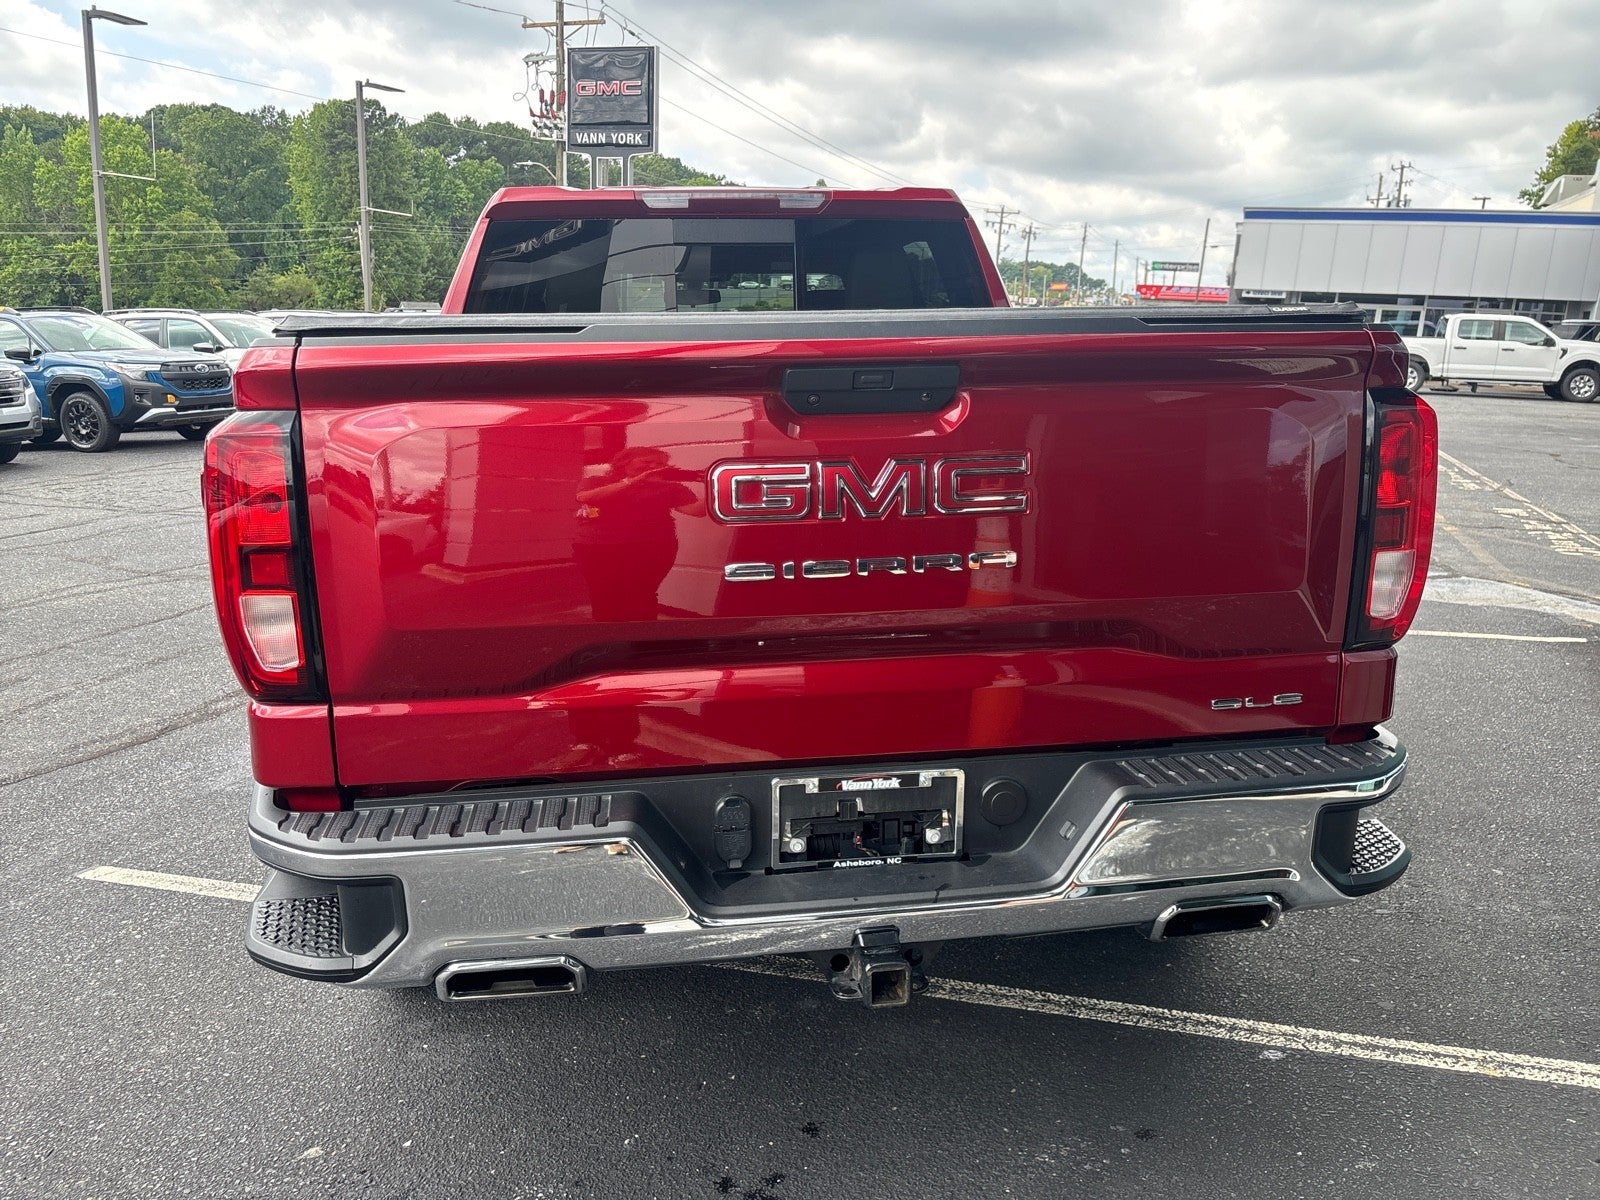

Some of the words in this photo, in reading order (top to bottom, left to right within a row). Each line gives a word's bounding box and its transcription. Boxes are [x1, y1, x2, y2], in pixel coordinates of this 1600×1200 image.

[576, 80, 642, 96] GMC
[576, 132, 606, 144] VANN
[611, 132, 643, 145] YORK
[1154, 262, 1199, 272] enterprise
[711, 452, 1030, 522] GMC
[724, 550, 1018, 582] SIERRA
[1211, 692, 1303, 711] SLE
[886, 857, 902, 865] NC
